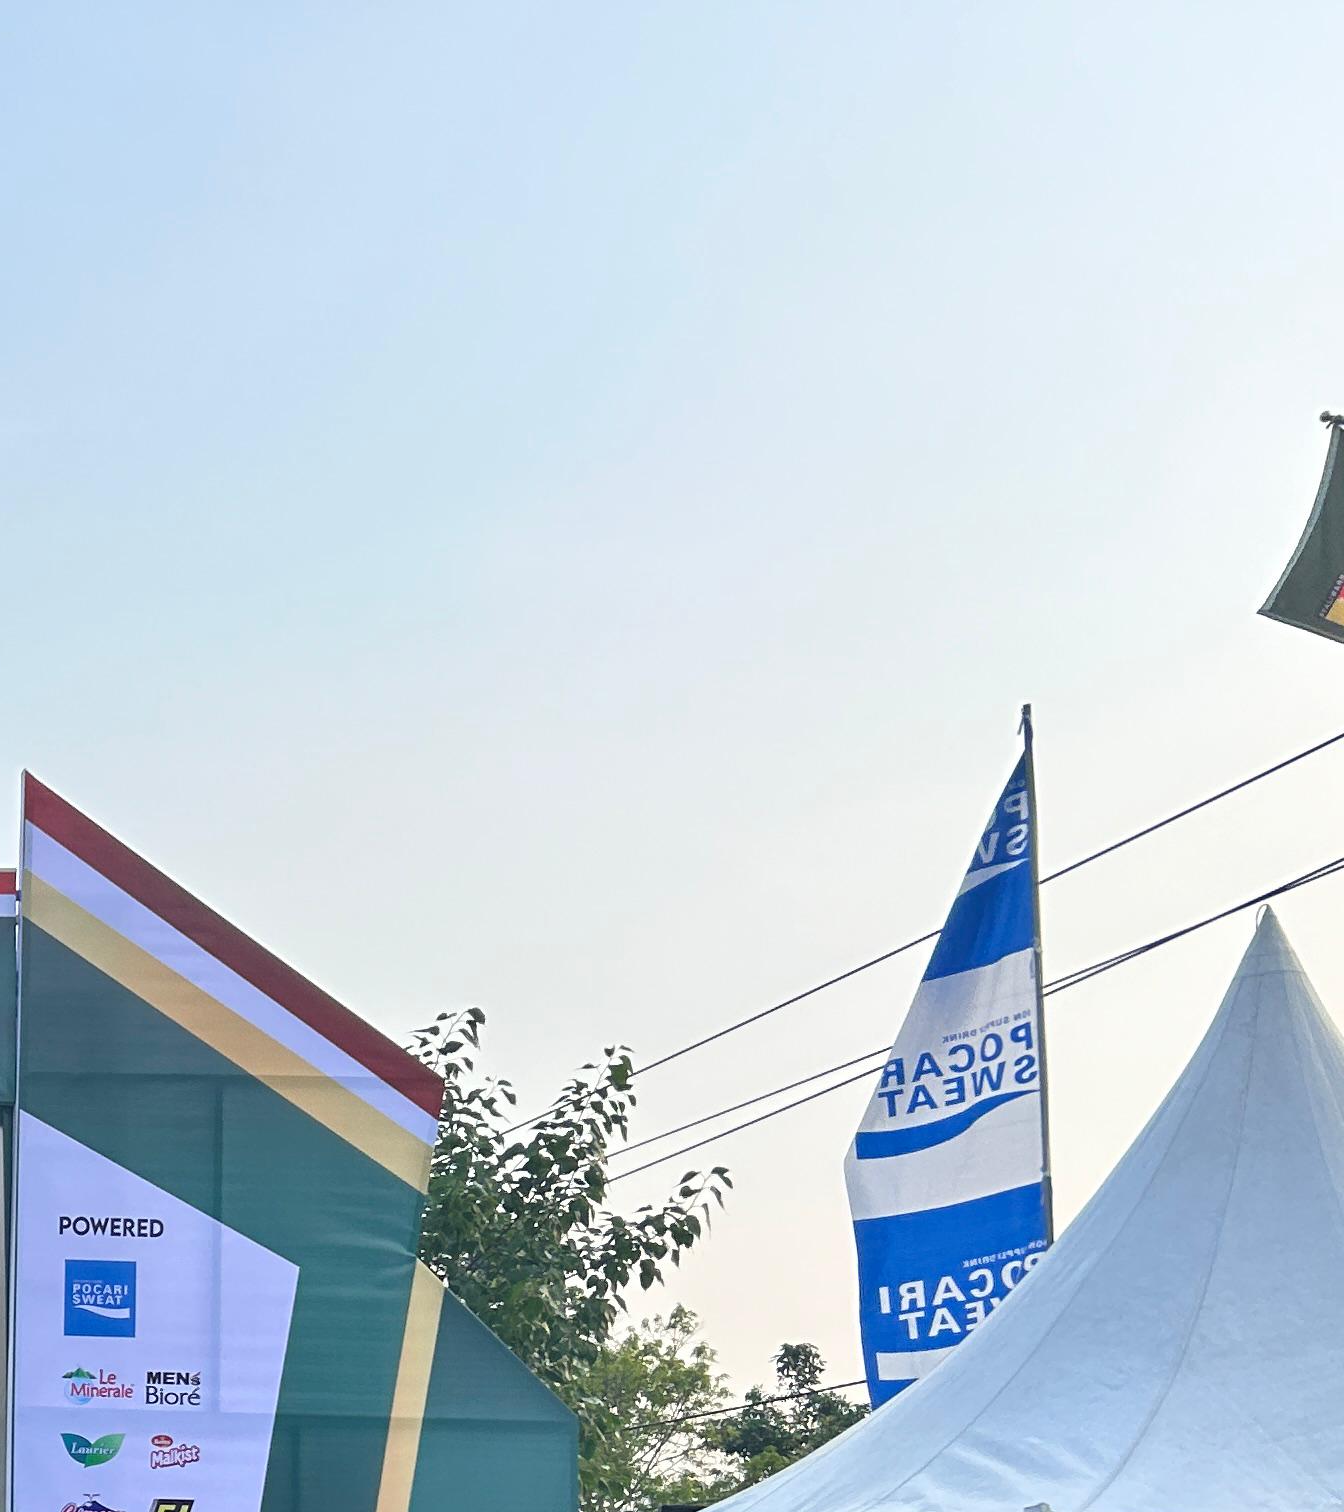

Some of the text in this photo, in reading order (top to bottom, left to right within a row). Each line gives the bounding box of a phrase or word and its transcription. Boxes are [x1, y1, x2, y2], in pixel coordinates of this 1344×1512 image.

[59, 1216, 164, 1238] POWERED
[72, 1283, 128, 1296] POCARI
[72, 1294, 123, 1305] SWEAT
[99, 1369, 116, 1385] Le
[70, 1384, 133, 1399] Minerale
[145, 1386, 200, 1406] Bioré
[70, 1441, 116, 1454] Laurier
[151, 1444, 200, 1469] Malkist
